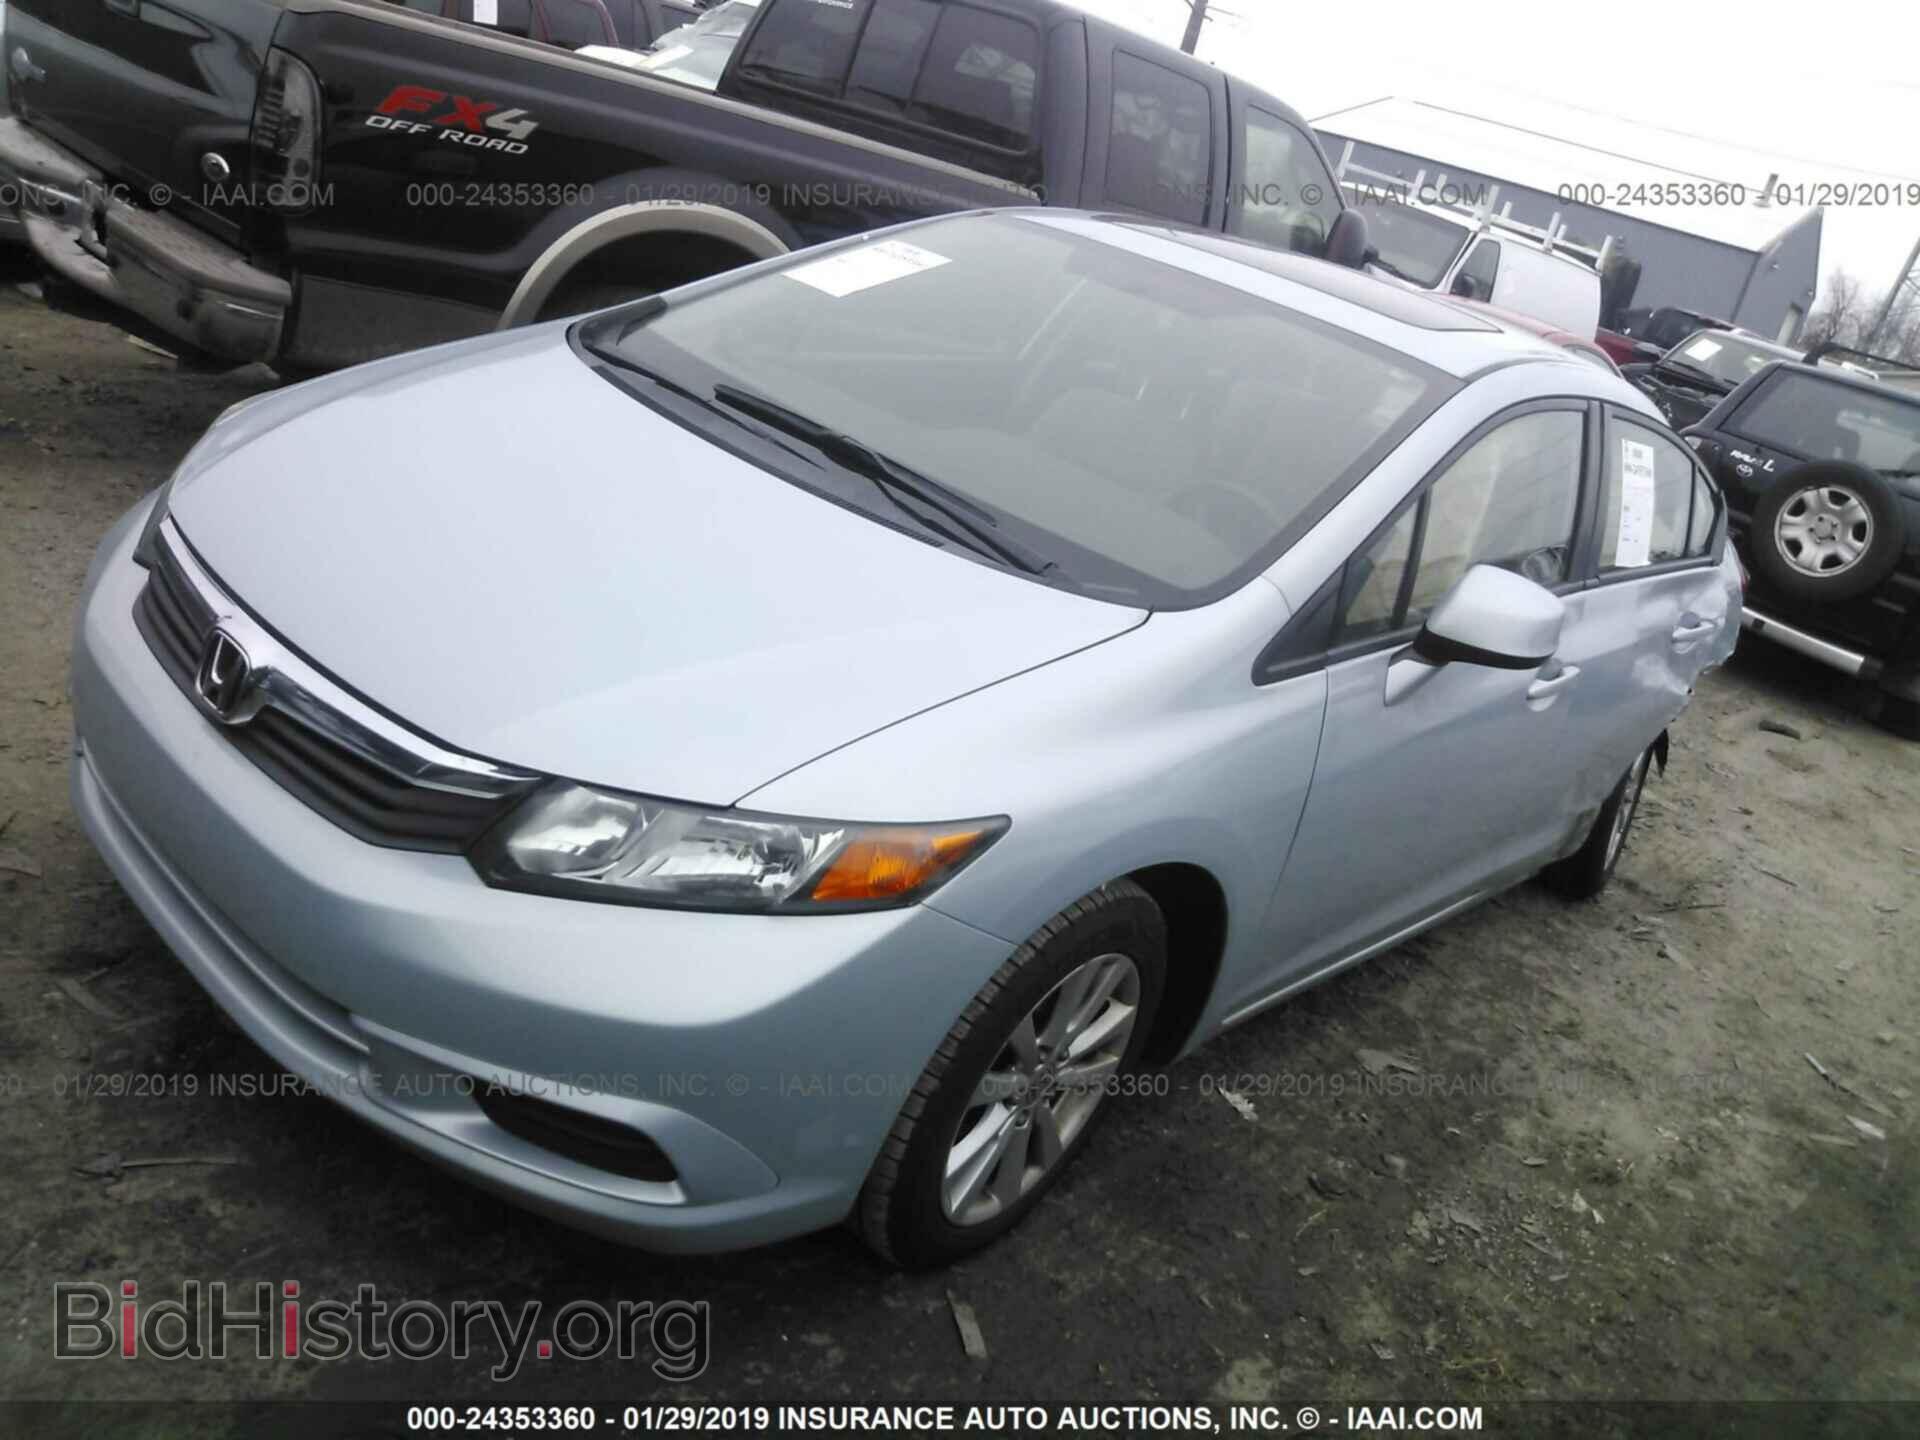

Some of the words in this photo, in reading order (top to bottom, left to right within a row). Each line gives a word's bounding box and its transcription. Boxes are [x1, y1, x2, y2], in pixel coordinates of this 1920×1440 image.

[365, 115, 433, 134] OFF
[438, 129, 529, 155] ROAD
[374, 84, 540, 140] FX4
